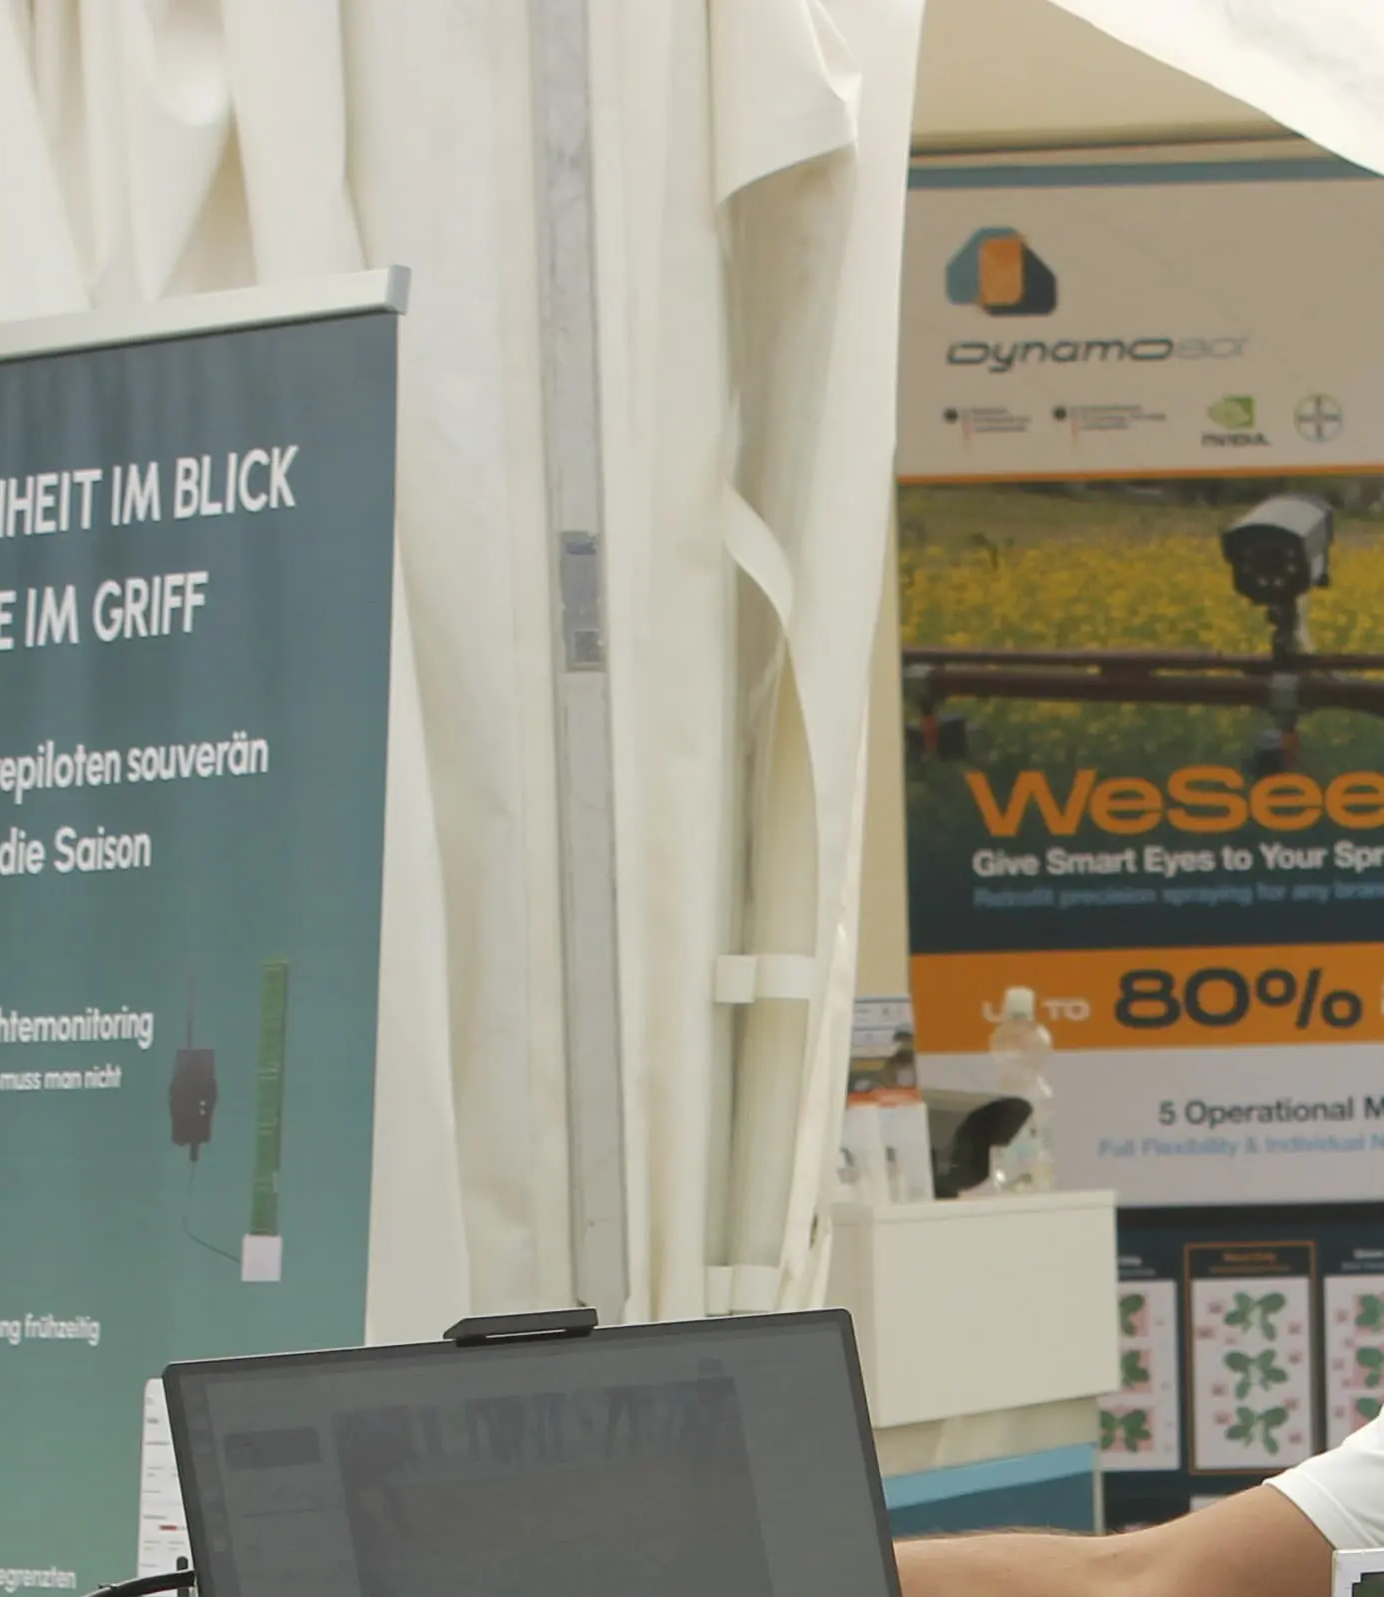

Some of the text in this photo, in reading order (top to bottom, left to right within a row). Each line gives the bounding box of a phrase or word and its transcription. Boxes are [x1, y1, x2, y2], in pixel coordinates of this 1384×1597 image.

[110, 462, 162, 526] IM
[173, 445, 299, 519] BLICK
[25, 584, 80, 648] IM
[92, 571, 209, 643] GRIFF
[127, 731, 268, 783] souverän
[53, 825, 151, 874] Saison
[972, 845, 1041, 878] Give
[1046, 845, 1137, 877] Smart
[1143, 844, 1216, 879] Eyes
[1221, 843, 1254, 873] to
[1259, 842, 1328, 873] Your
[1042, 997, 1091, 1022] TO
[1113, 966, 1363, 1031] 80%
[44, 1071, 81, 1092] man
[84, 1064, 122, 1091] nicht
[1158, 1101, 1177, 1126] 5
[1184, 1098, 1356, 1129] Operational
